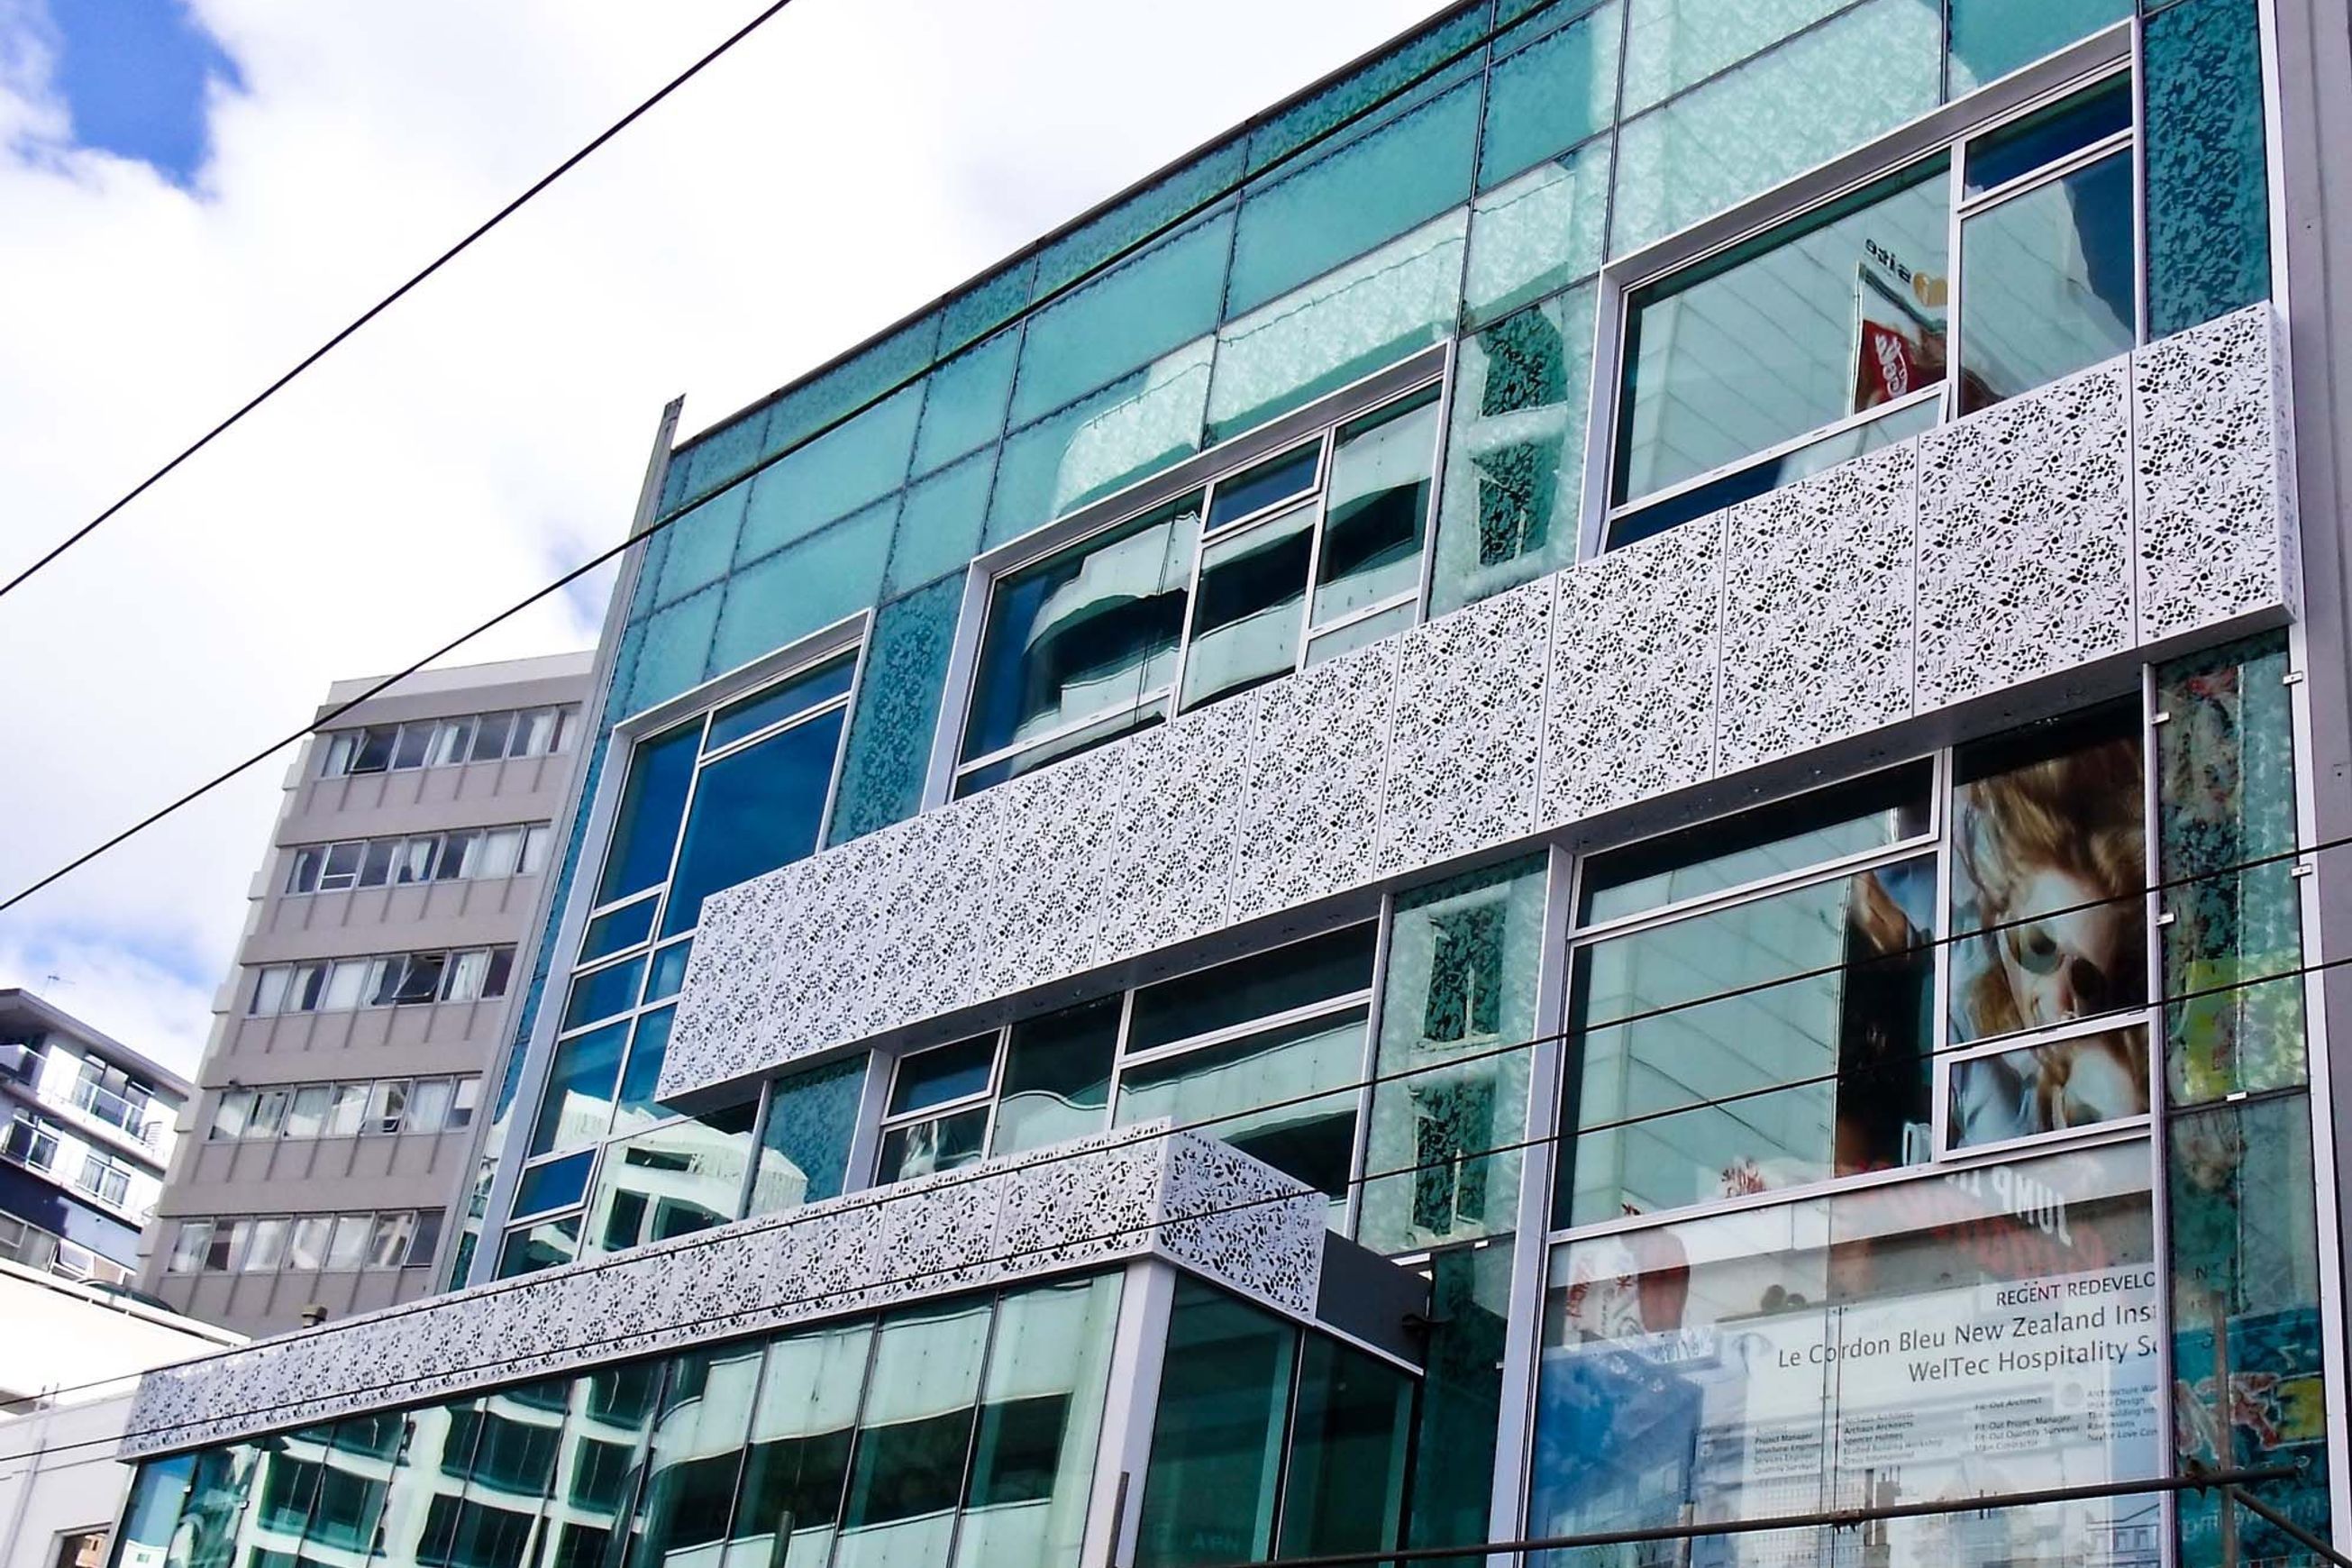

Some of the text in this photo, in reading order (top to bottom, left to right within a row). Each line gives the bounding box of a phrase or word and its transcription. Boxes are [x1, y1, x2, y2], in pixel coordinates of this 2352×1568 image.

[1996, 1283, 2062, 1307] REGENT
[1778, 1348, 1801, 1368] Le
[1809, 1336, 1890, 1364] Cordon
[1899, 1327, 1946, 1352] Bleu
[1954, 1323, 2004, 1345] New
[2012, 1305, 2105, 1338] Zealand
[1908, 1355, 1991, 1383] WelTec
[1998, 1340, 2129, 1372] Hospitality
